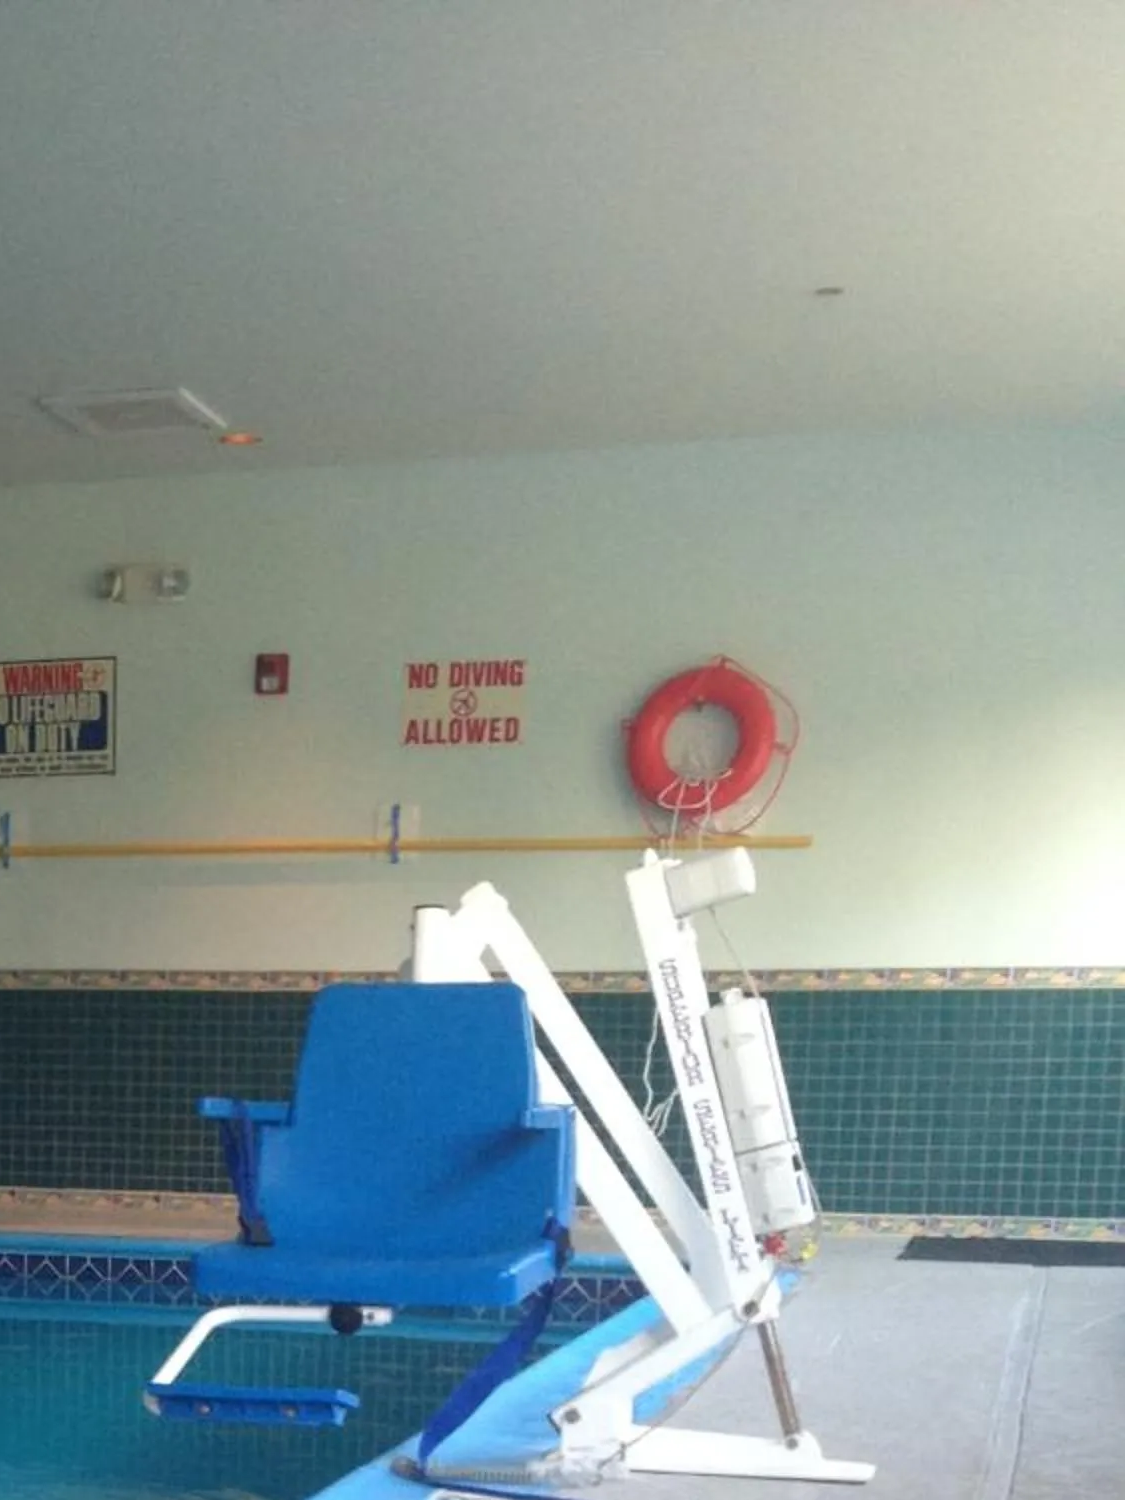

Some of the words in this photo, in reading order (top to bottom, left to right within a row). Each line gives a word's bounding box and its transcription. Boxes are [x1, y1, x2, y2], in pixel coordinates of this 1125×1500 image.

[406, 662, 439, 689] NO
[448, 659, 525, 688] DIVING
[404, 717, 521, 745] ALLOWED
